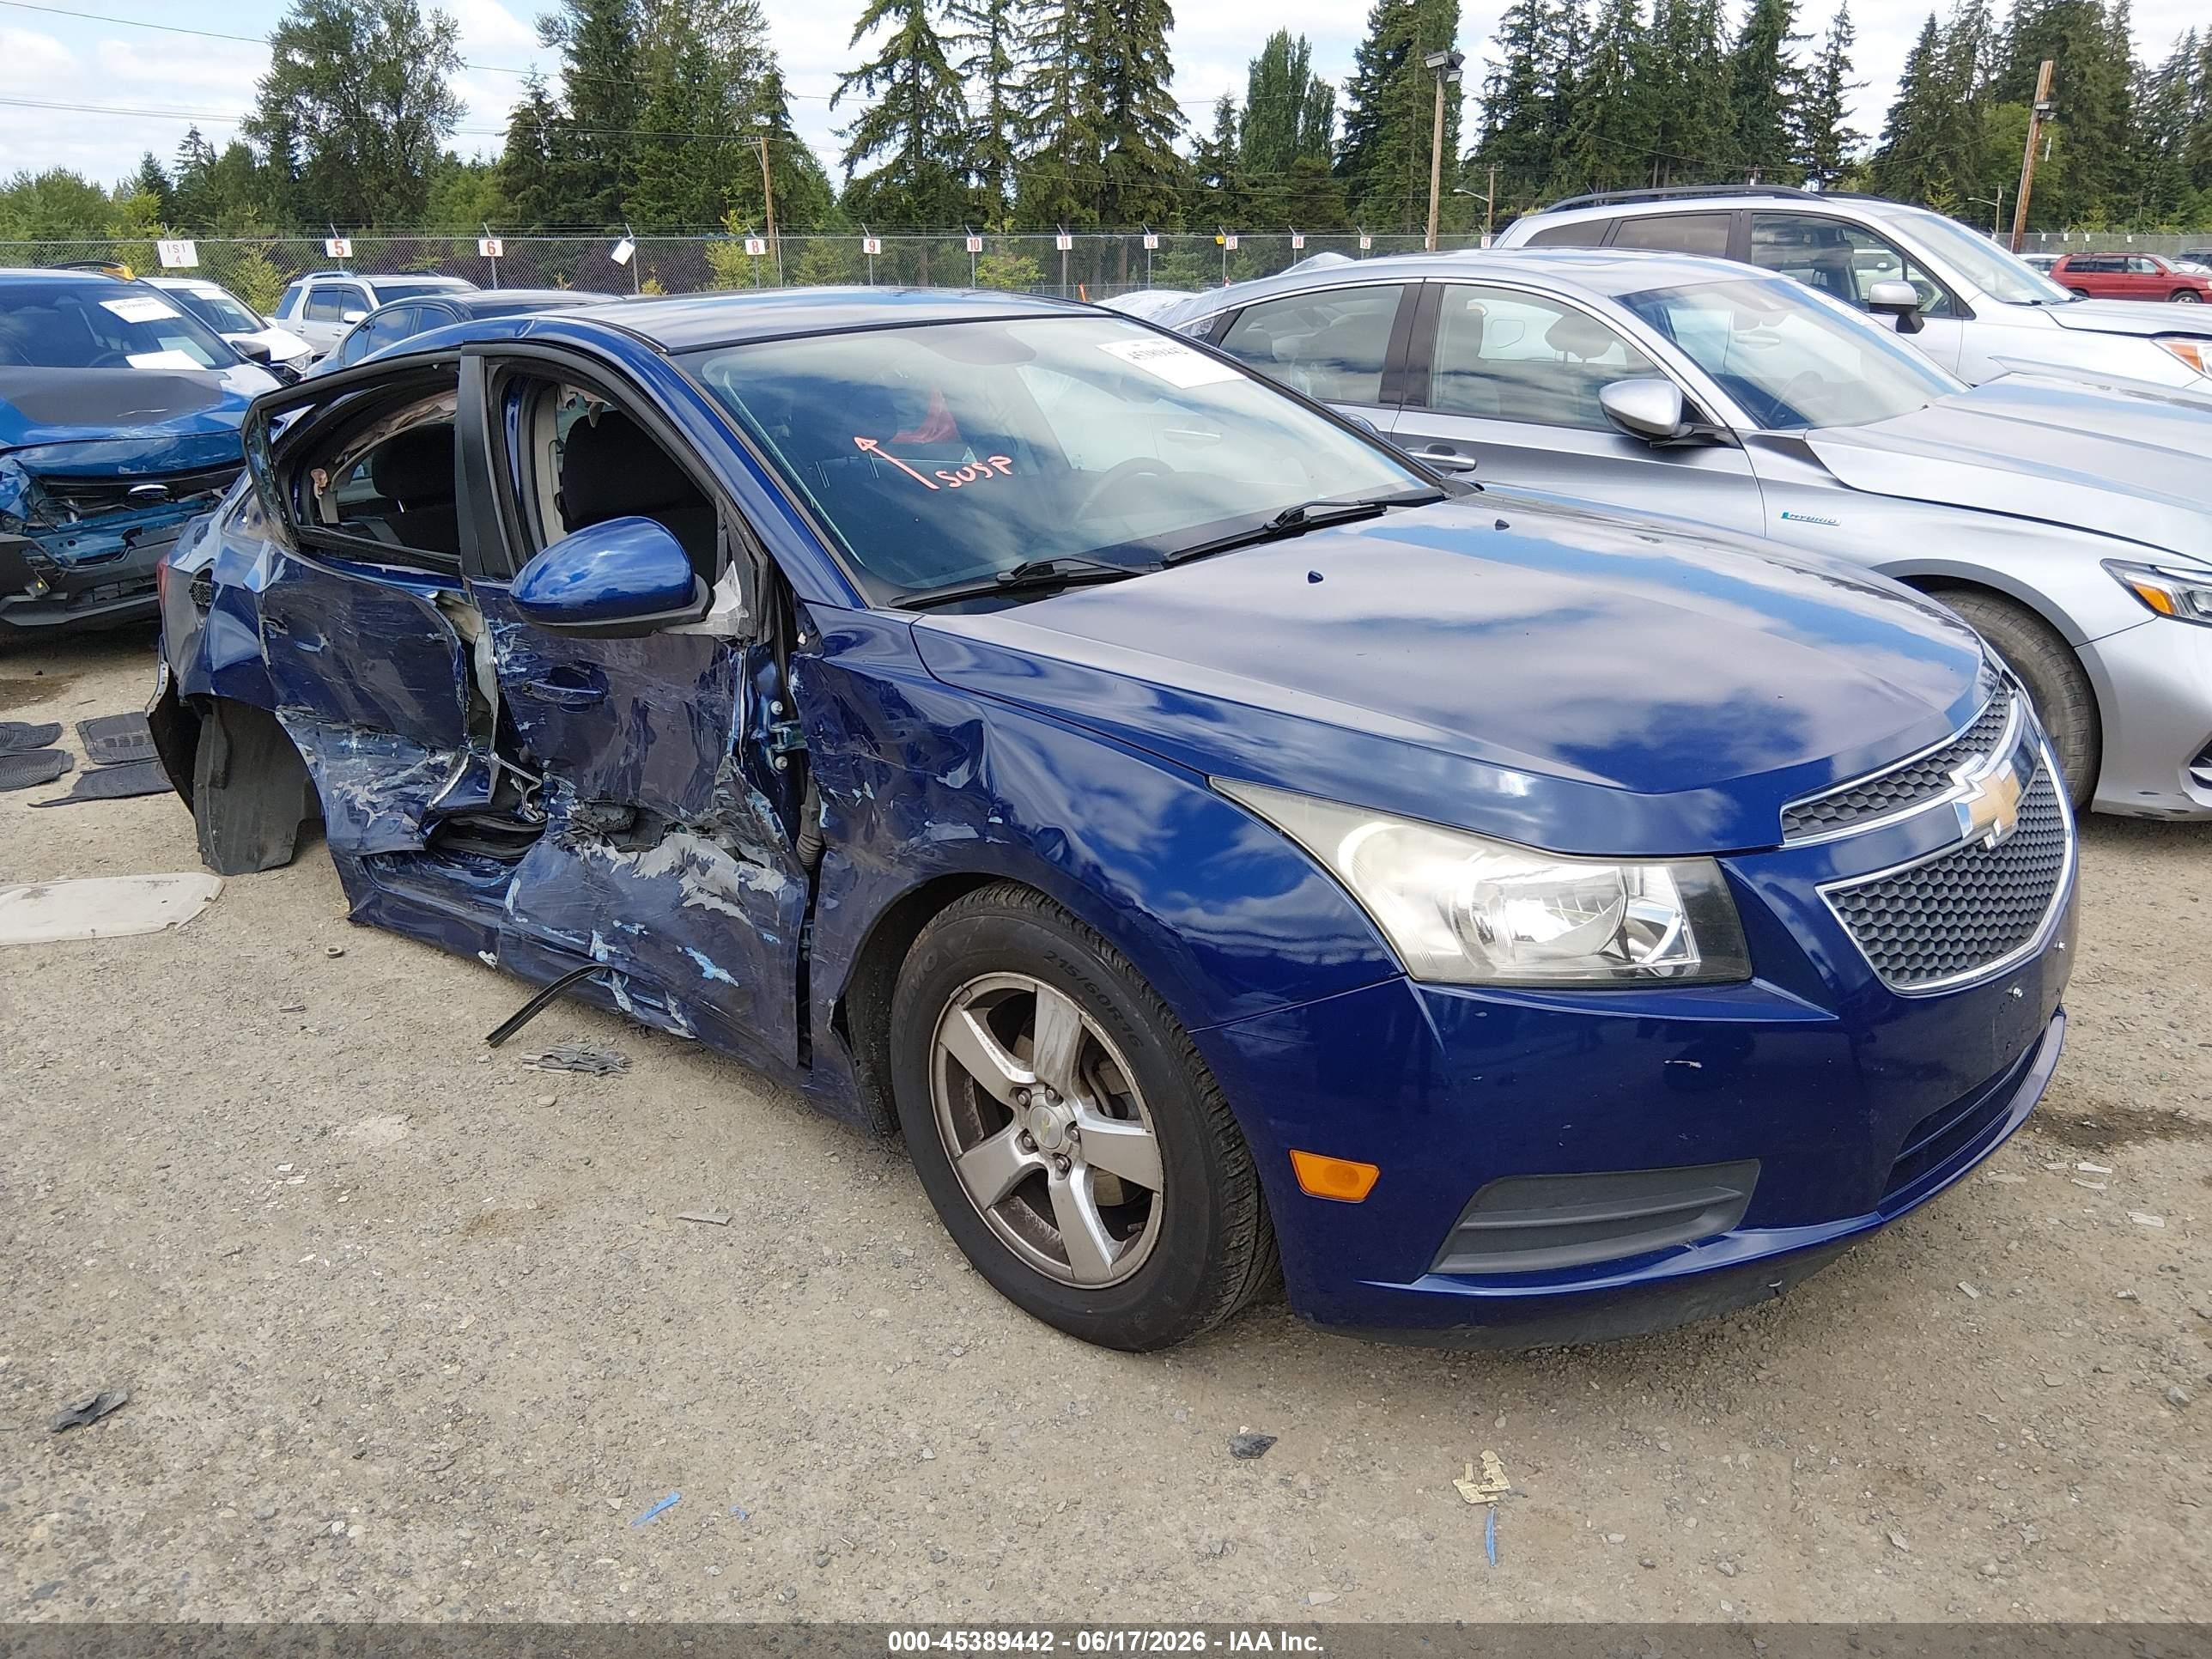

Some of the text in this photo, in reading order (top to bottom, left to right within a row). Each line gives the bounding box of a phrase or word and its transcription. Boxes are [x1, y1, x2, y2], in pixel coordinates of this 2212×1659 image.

[486, 240, 496, 255] 6
[751, 240, 760, 253] 8
[868, 240, 876, 252] 9
[969, 238, 980, 250] 10
[1060, 237, 1068, 248] 11
[1146, 237, 1155, 248] 12
[1228, 238, 1236, 248] 13
[1294, 237, 1302, 247] 14
[1361, 238, 1369, 248] 15
[335, 240, 344, 256] 5
[175, 256, 182, 265] 4
